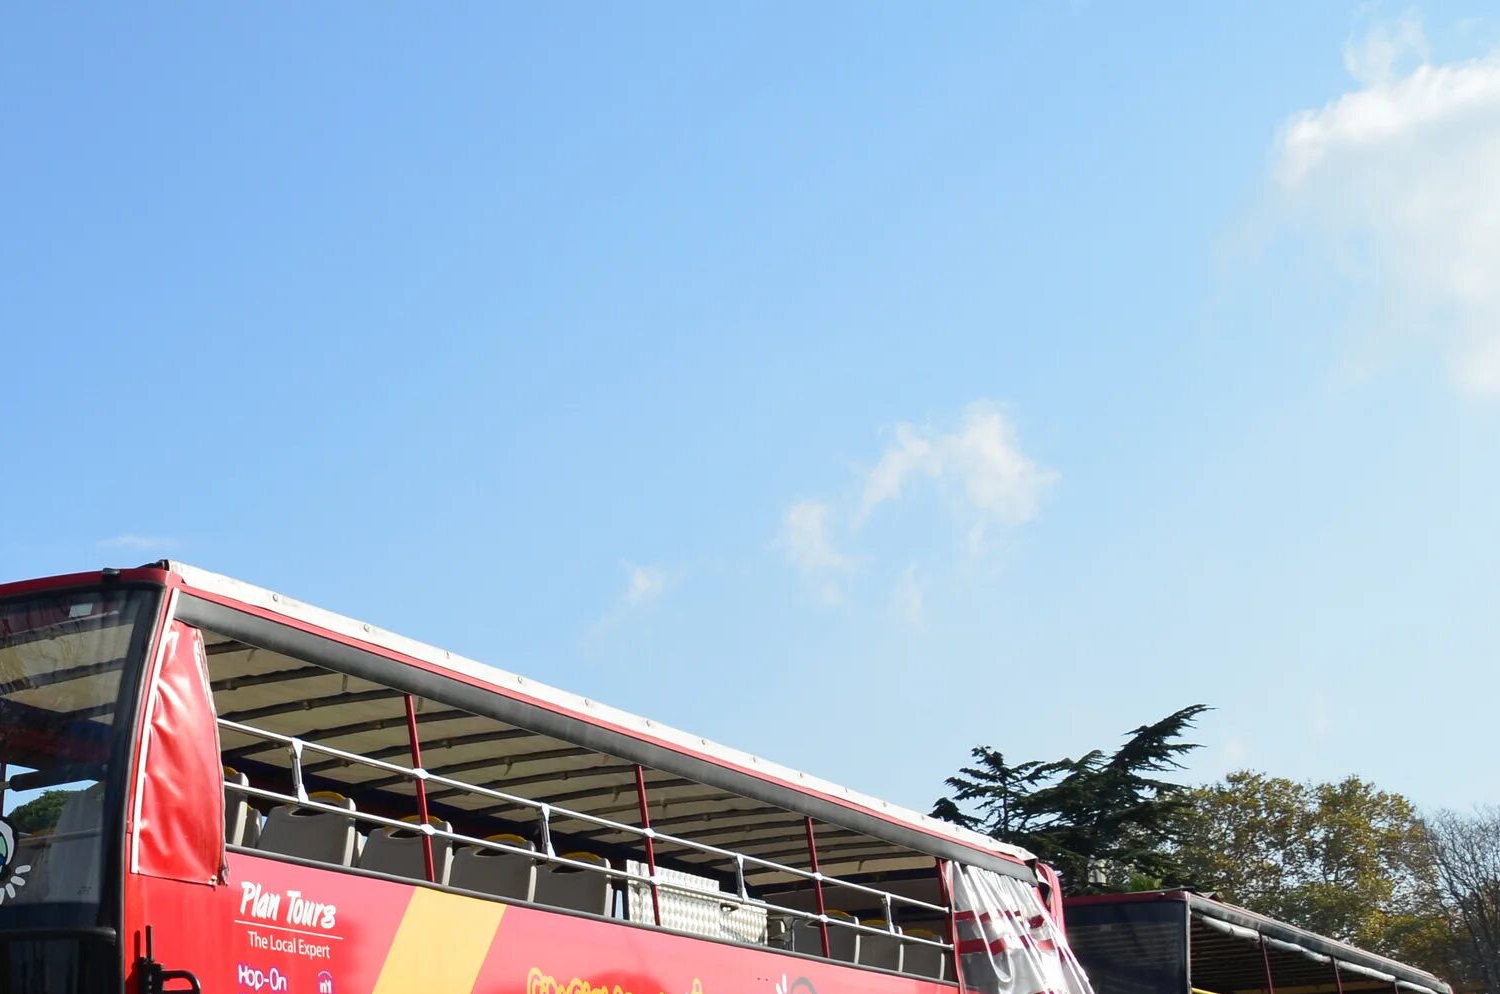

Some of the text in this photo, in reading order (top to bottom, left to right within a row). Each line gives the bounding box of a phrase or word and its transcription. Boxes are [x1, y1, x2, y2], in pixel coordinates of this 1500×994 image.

[240, 881, 337, 929] Plan Tours
[248, 931, 331, 960] The Local Expert
[238, 964, 287, 991] Hop-On
